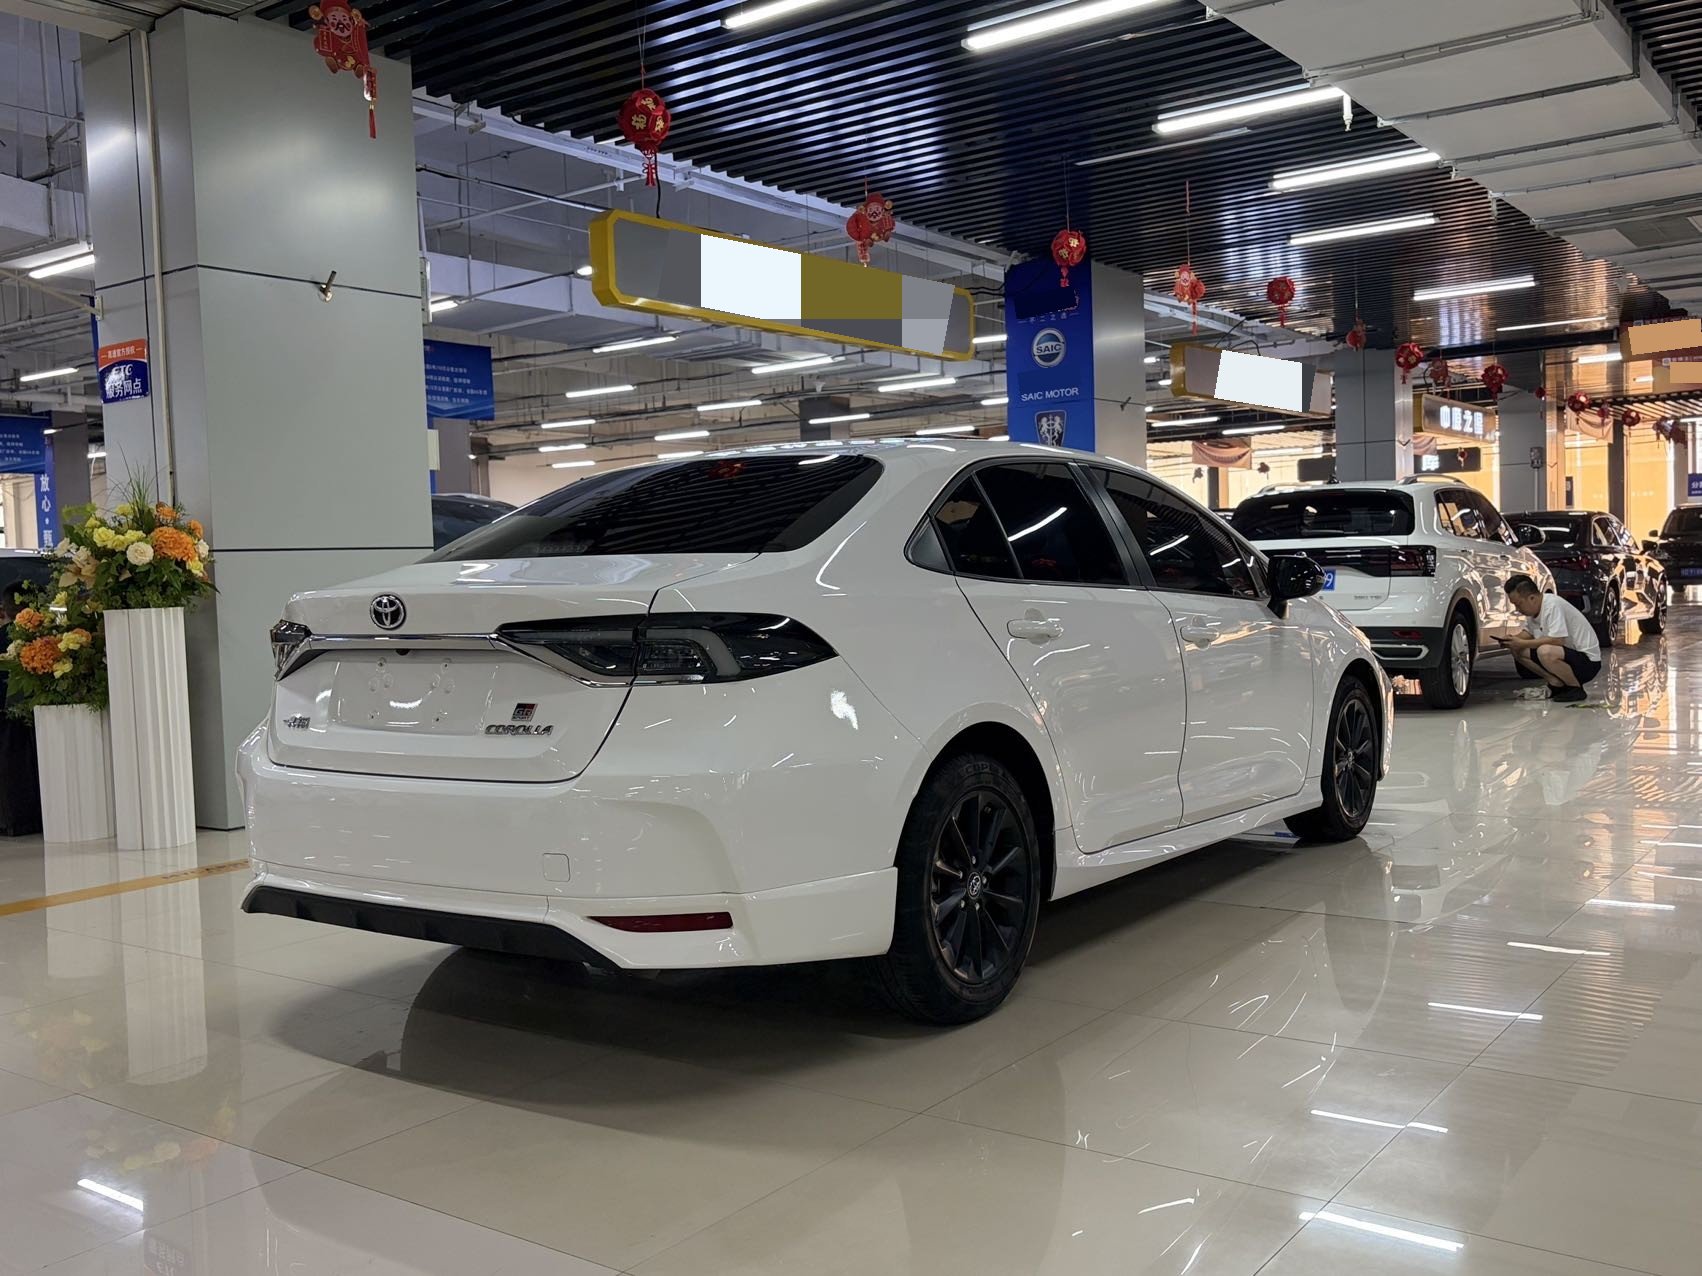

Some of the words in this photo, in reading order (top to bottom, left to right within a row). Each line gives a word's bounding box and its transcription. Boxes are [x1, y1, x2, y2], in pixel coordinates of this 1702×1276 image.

[1036, 344, 1062, 353] SAIC
[1021, 392, 1043, 401] SAIC
[1045, 387, 1079, 398] MOTOR
[485, 724, 553, 735] COROLLA
